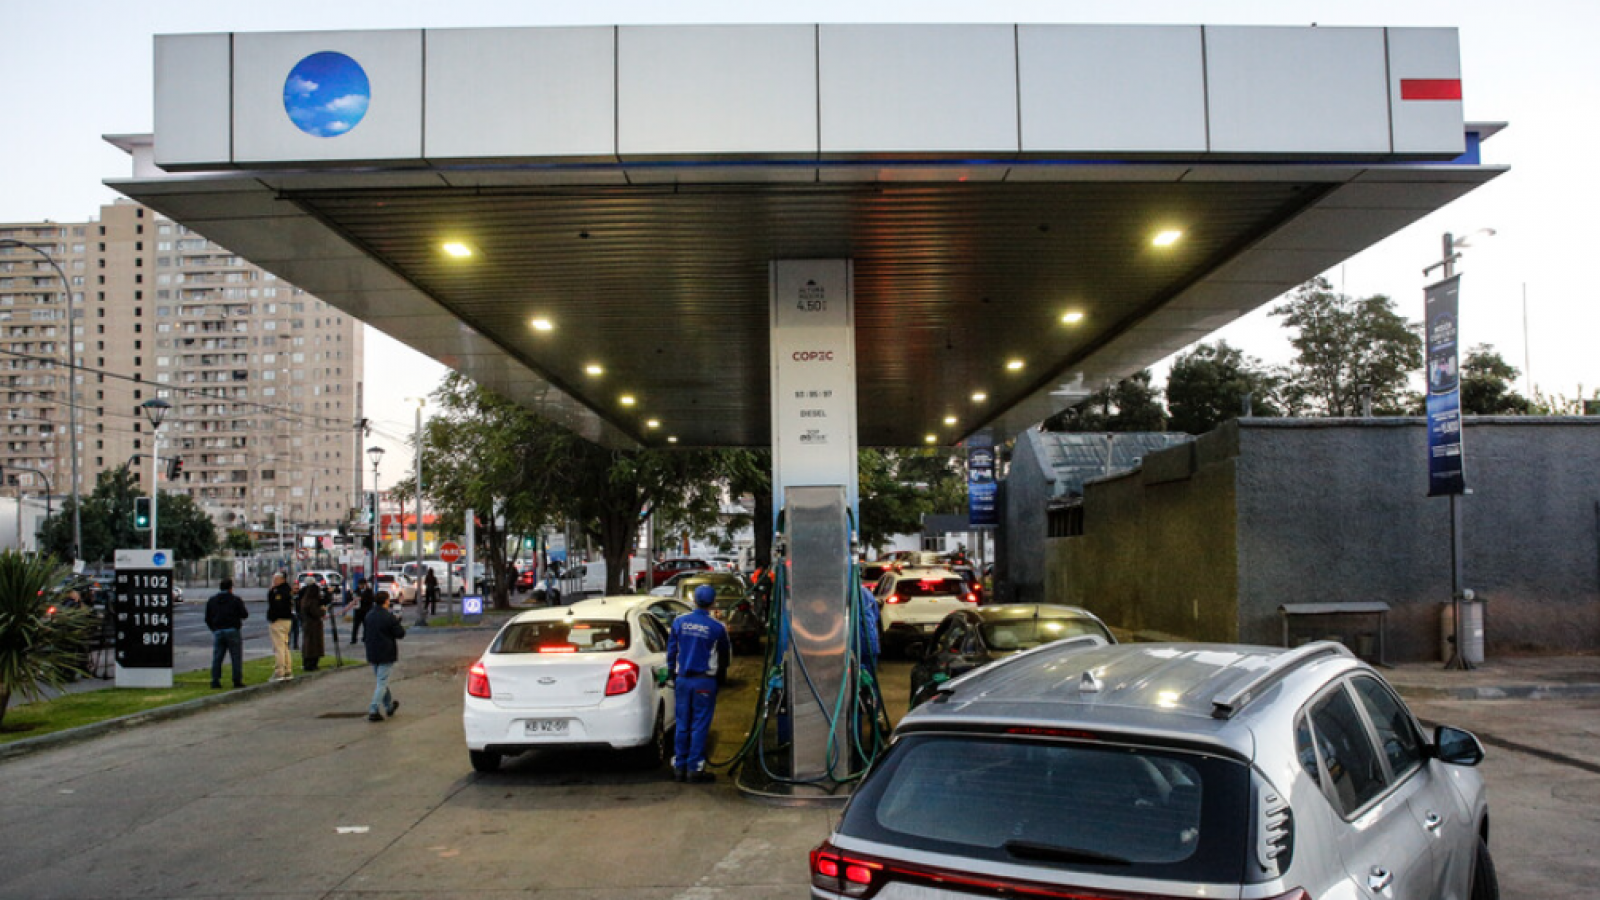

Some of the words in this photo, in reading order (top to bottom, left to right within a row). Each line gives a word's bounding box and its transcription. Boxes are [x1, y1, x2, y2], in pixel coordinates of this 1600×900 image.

[792, 351, 834, 361] COPEC
[134, 575, 168, 588] 1102
[134, 594, 168, 607] 1133
[143, 632, 169, 645] 907
